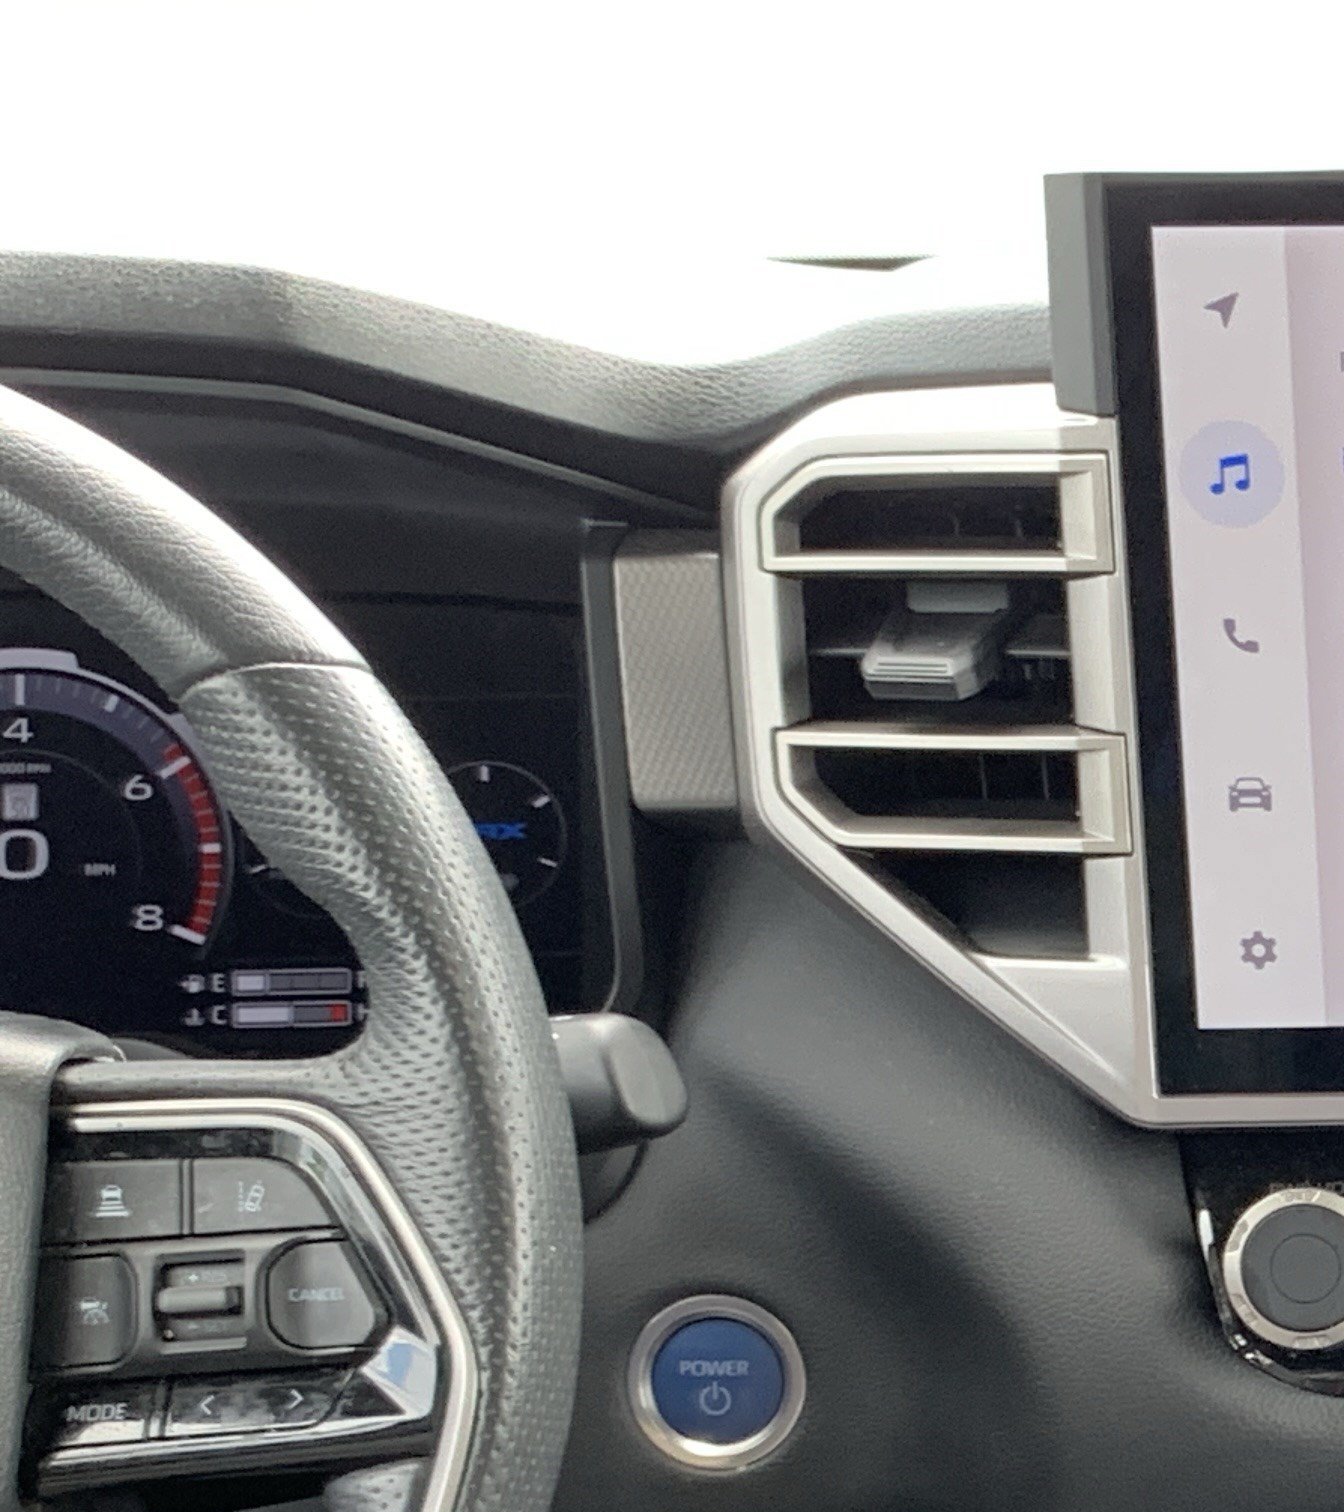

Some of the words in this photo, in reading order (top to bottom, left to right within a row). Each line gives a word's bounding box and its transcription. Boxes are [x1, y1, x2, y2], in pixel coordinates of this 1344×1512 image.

[3, 717, 34, 743] 4
[123, 774, 154, 801] 6
[0, 829, 49, 880] 0
[132, 903, 164, 932] 8
[679, 1360, 750, 1377] POWER
[65, 1401, 129, 1422] MODE
